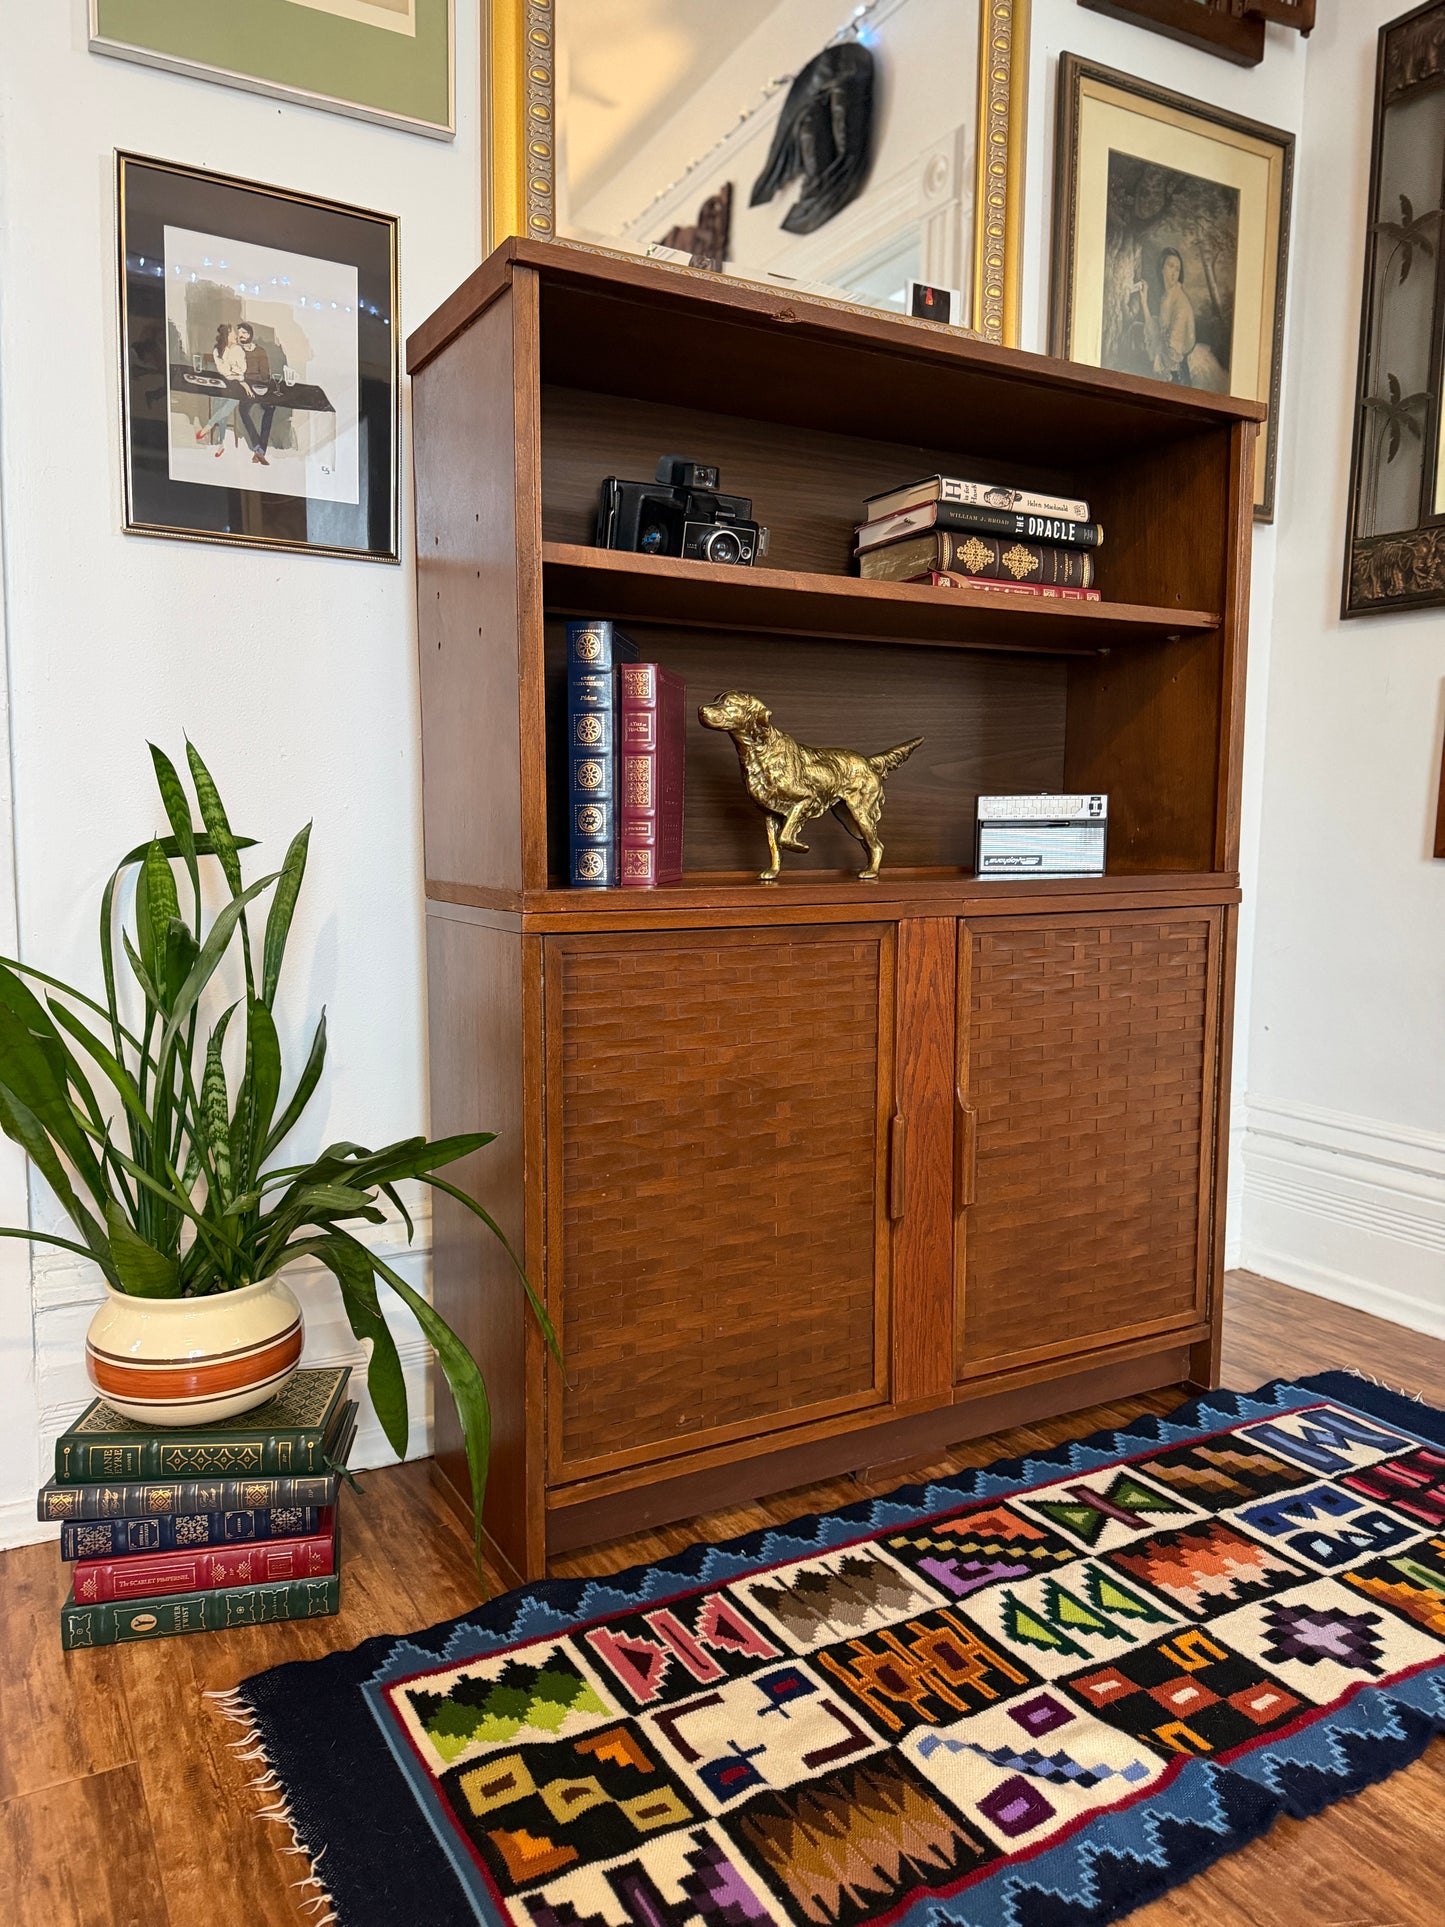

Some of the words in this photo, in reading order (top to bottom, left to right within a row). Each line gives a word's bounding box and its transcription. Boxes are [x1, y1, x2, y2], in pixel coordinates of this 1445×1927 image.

[945, 481, 961, 500] H
[969, 484, 977, 504] Hawk
[1027, 499, 1042, 509] Helen
[949, 511, 978, 521] WILLIAM
[987, 518, 1010, 526] BROAD
[1015, 515, 1025, 533] THE
[1028, 517, 1076, 541] ORACLE
[104, 1450, 113, 1474] JANE
[114, 1449, 122, 1474] EYRE
[129, 1578, 155, 1586] SCARLET
[156, 1574, 190, 1583] PIMPERNEL
[181, 1606, 189, 1628] TWIST
